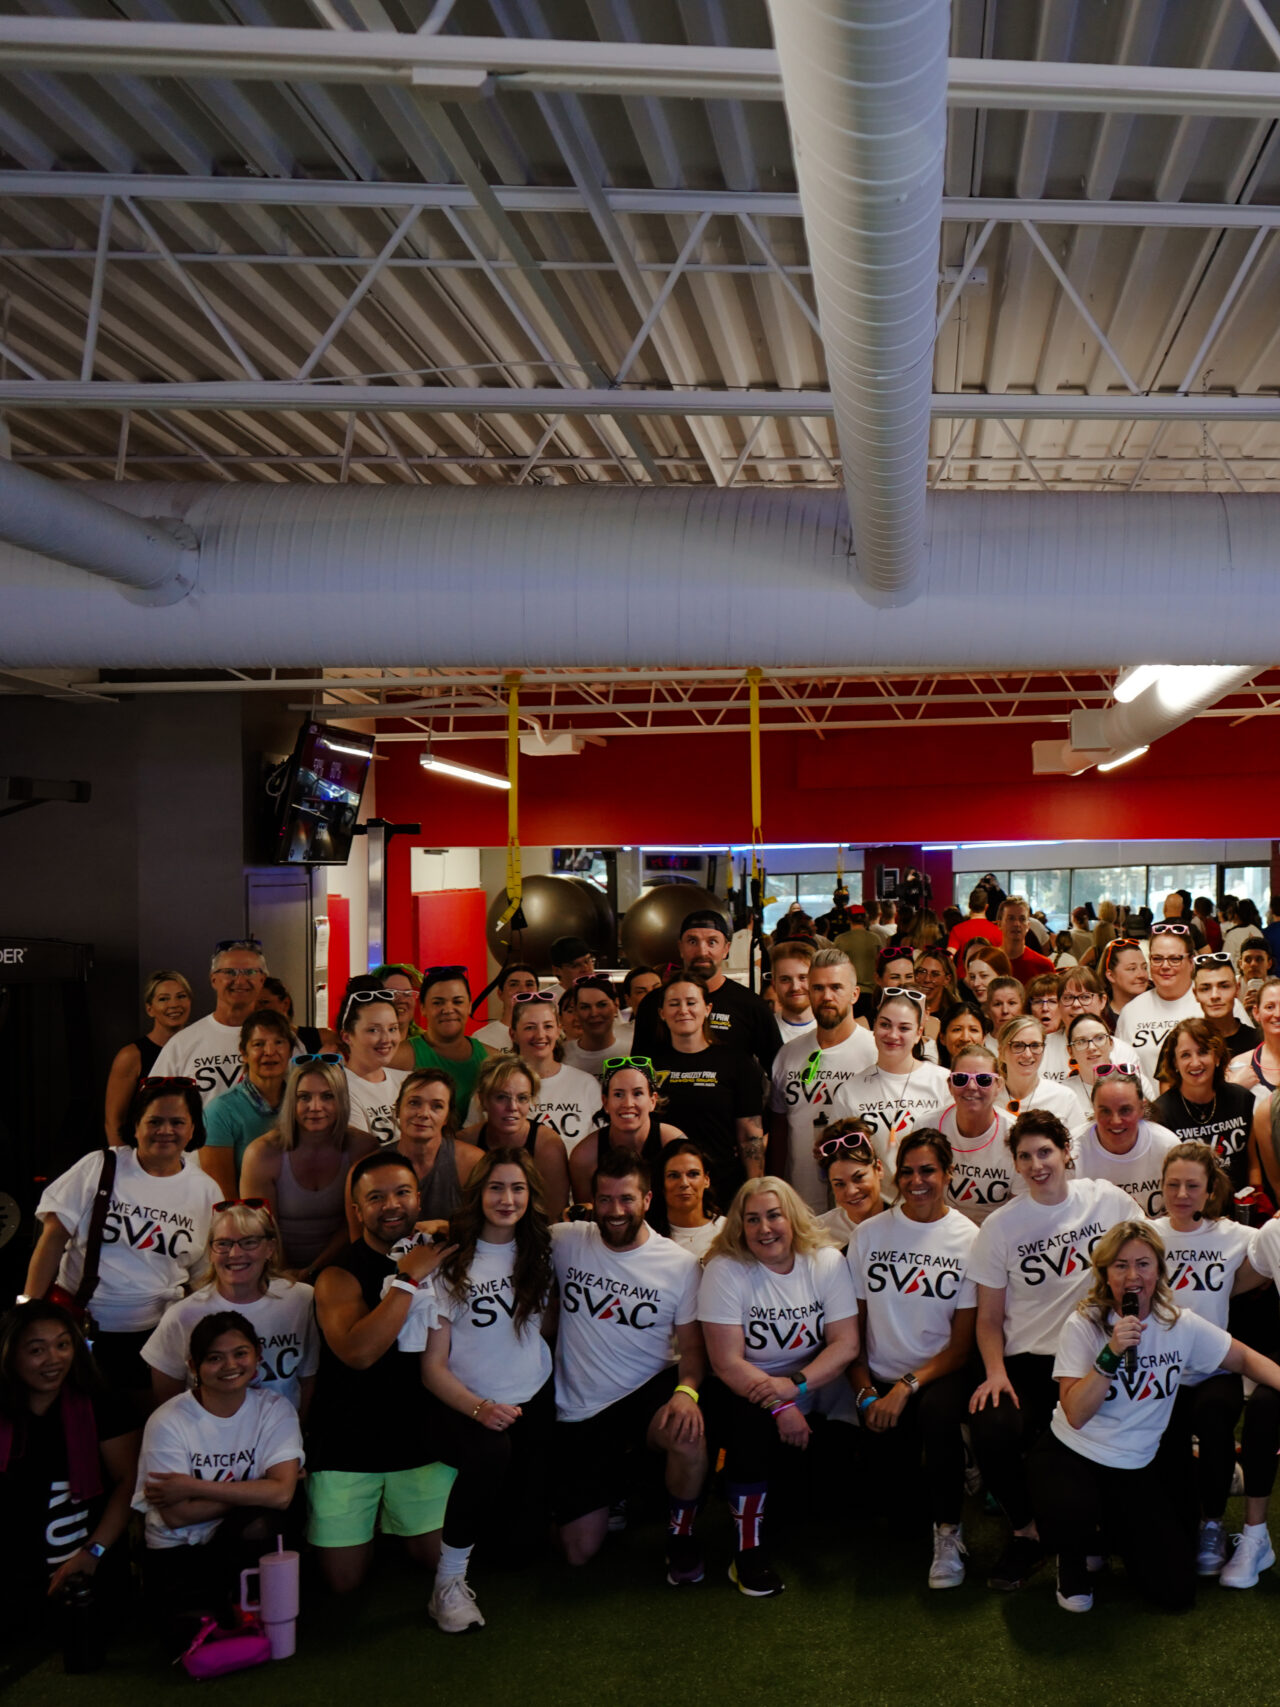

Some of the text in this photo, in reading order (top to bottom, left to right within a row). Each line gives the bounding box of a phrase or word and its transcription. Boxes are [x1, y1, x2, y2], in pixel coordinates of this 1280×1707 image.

[0, 948, 25, 964] ER
[195, 1065, 245, 1092] SV
[1175, 1116, 1247, 1139] SWEATCRAWL
[1017, 1221, 1107, 1257] SWEATCRAWL
[869, 1251, 962, 1271] SWEATCRAWL
[566, 1267, 661, 1303] SWEATCRAWL
[867, 1263, 960, 1300] SVAC
[562, 1281, 658, 1329] SVAC
